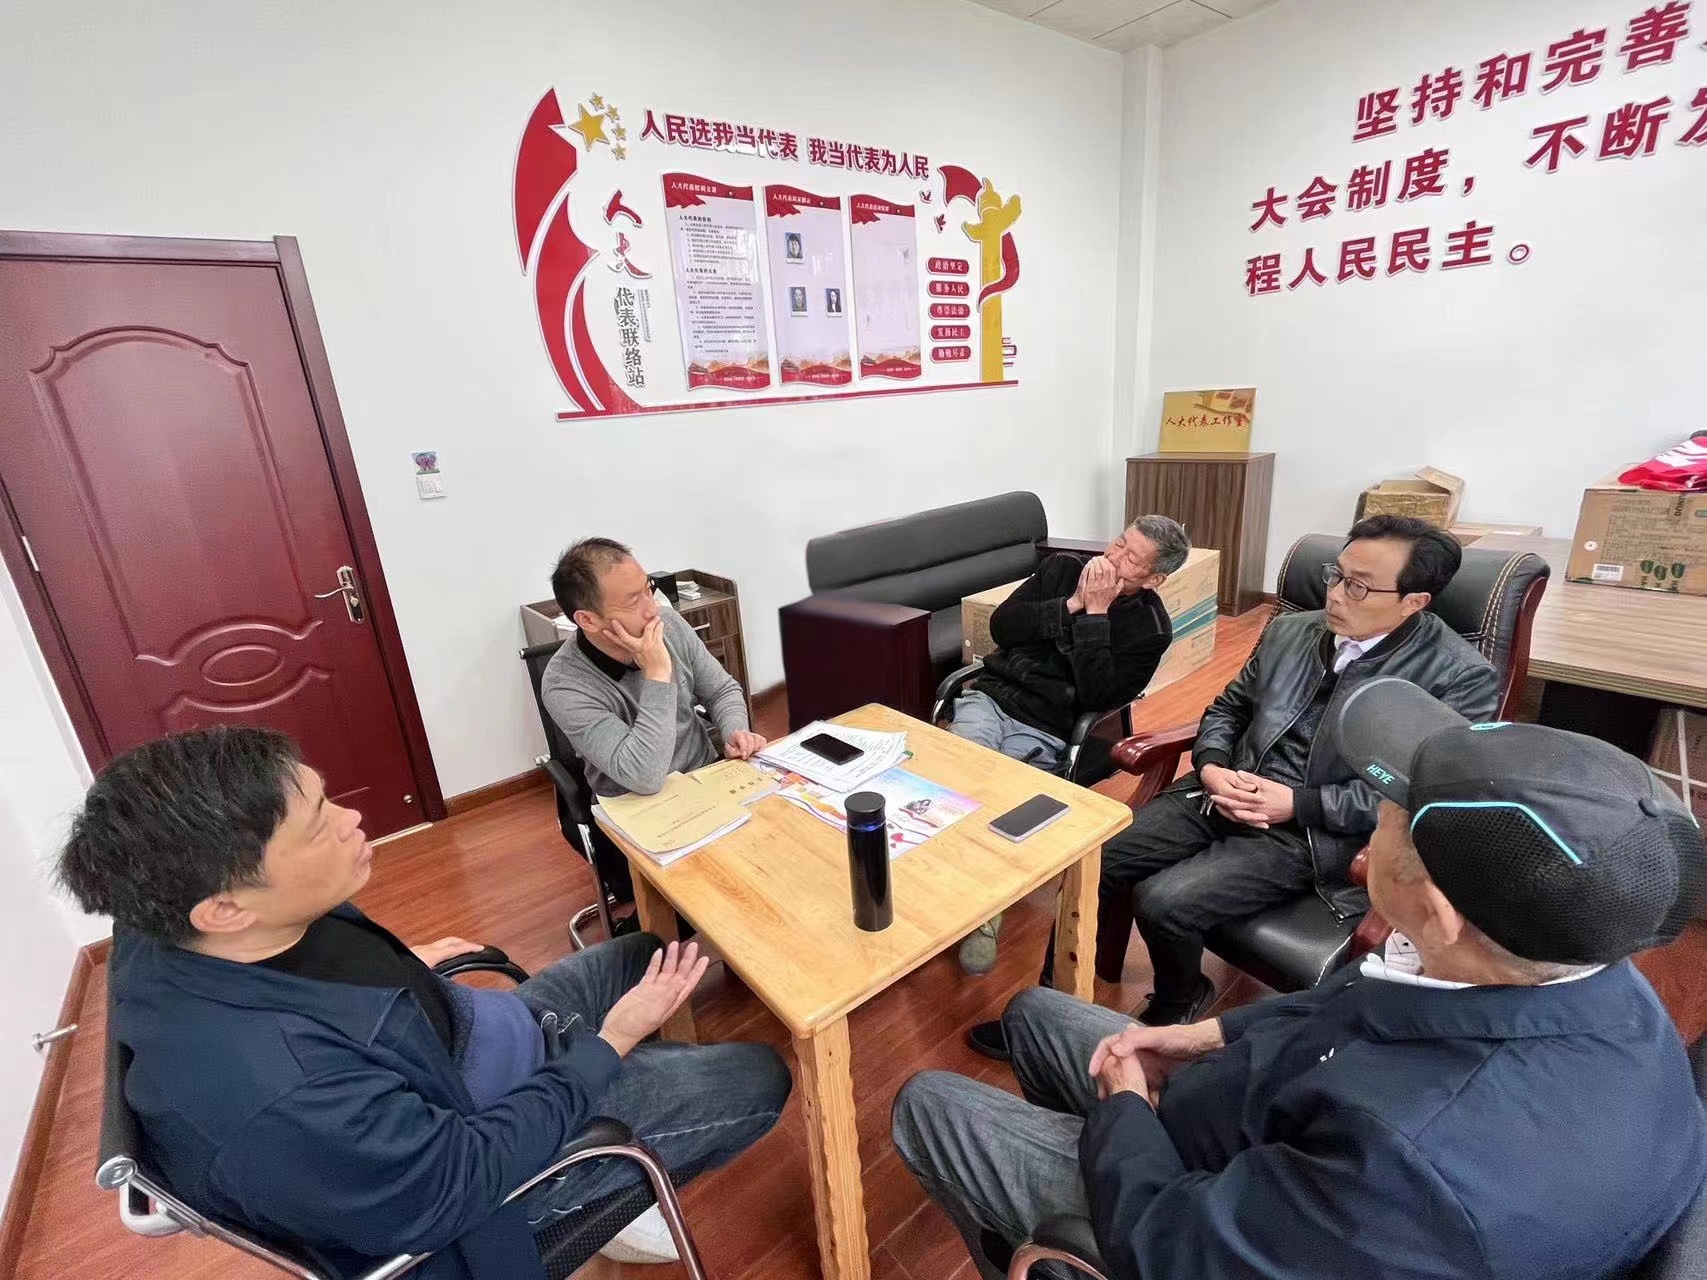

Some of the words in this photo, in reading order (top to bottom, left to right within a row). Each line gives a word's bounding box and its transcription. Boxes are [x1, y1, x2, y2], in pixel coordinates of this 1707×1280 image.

[1353, 1, 1707, 141] 坚持和完善
[641, 110, 798, 160] 人民选我当代表
[809, 138, 929, 178] 我当代表为人民
[1245, 220, 1530, 294] 程人民民主。
[616, 287, 645, 386] 代表联络站
[1165, 414, 1243, 427] 人大代表工作室
[1366, 764, 1395, 785] HEYE
